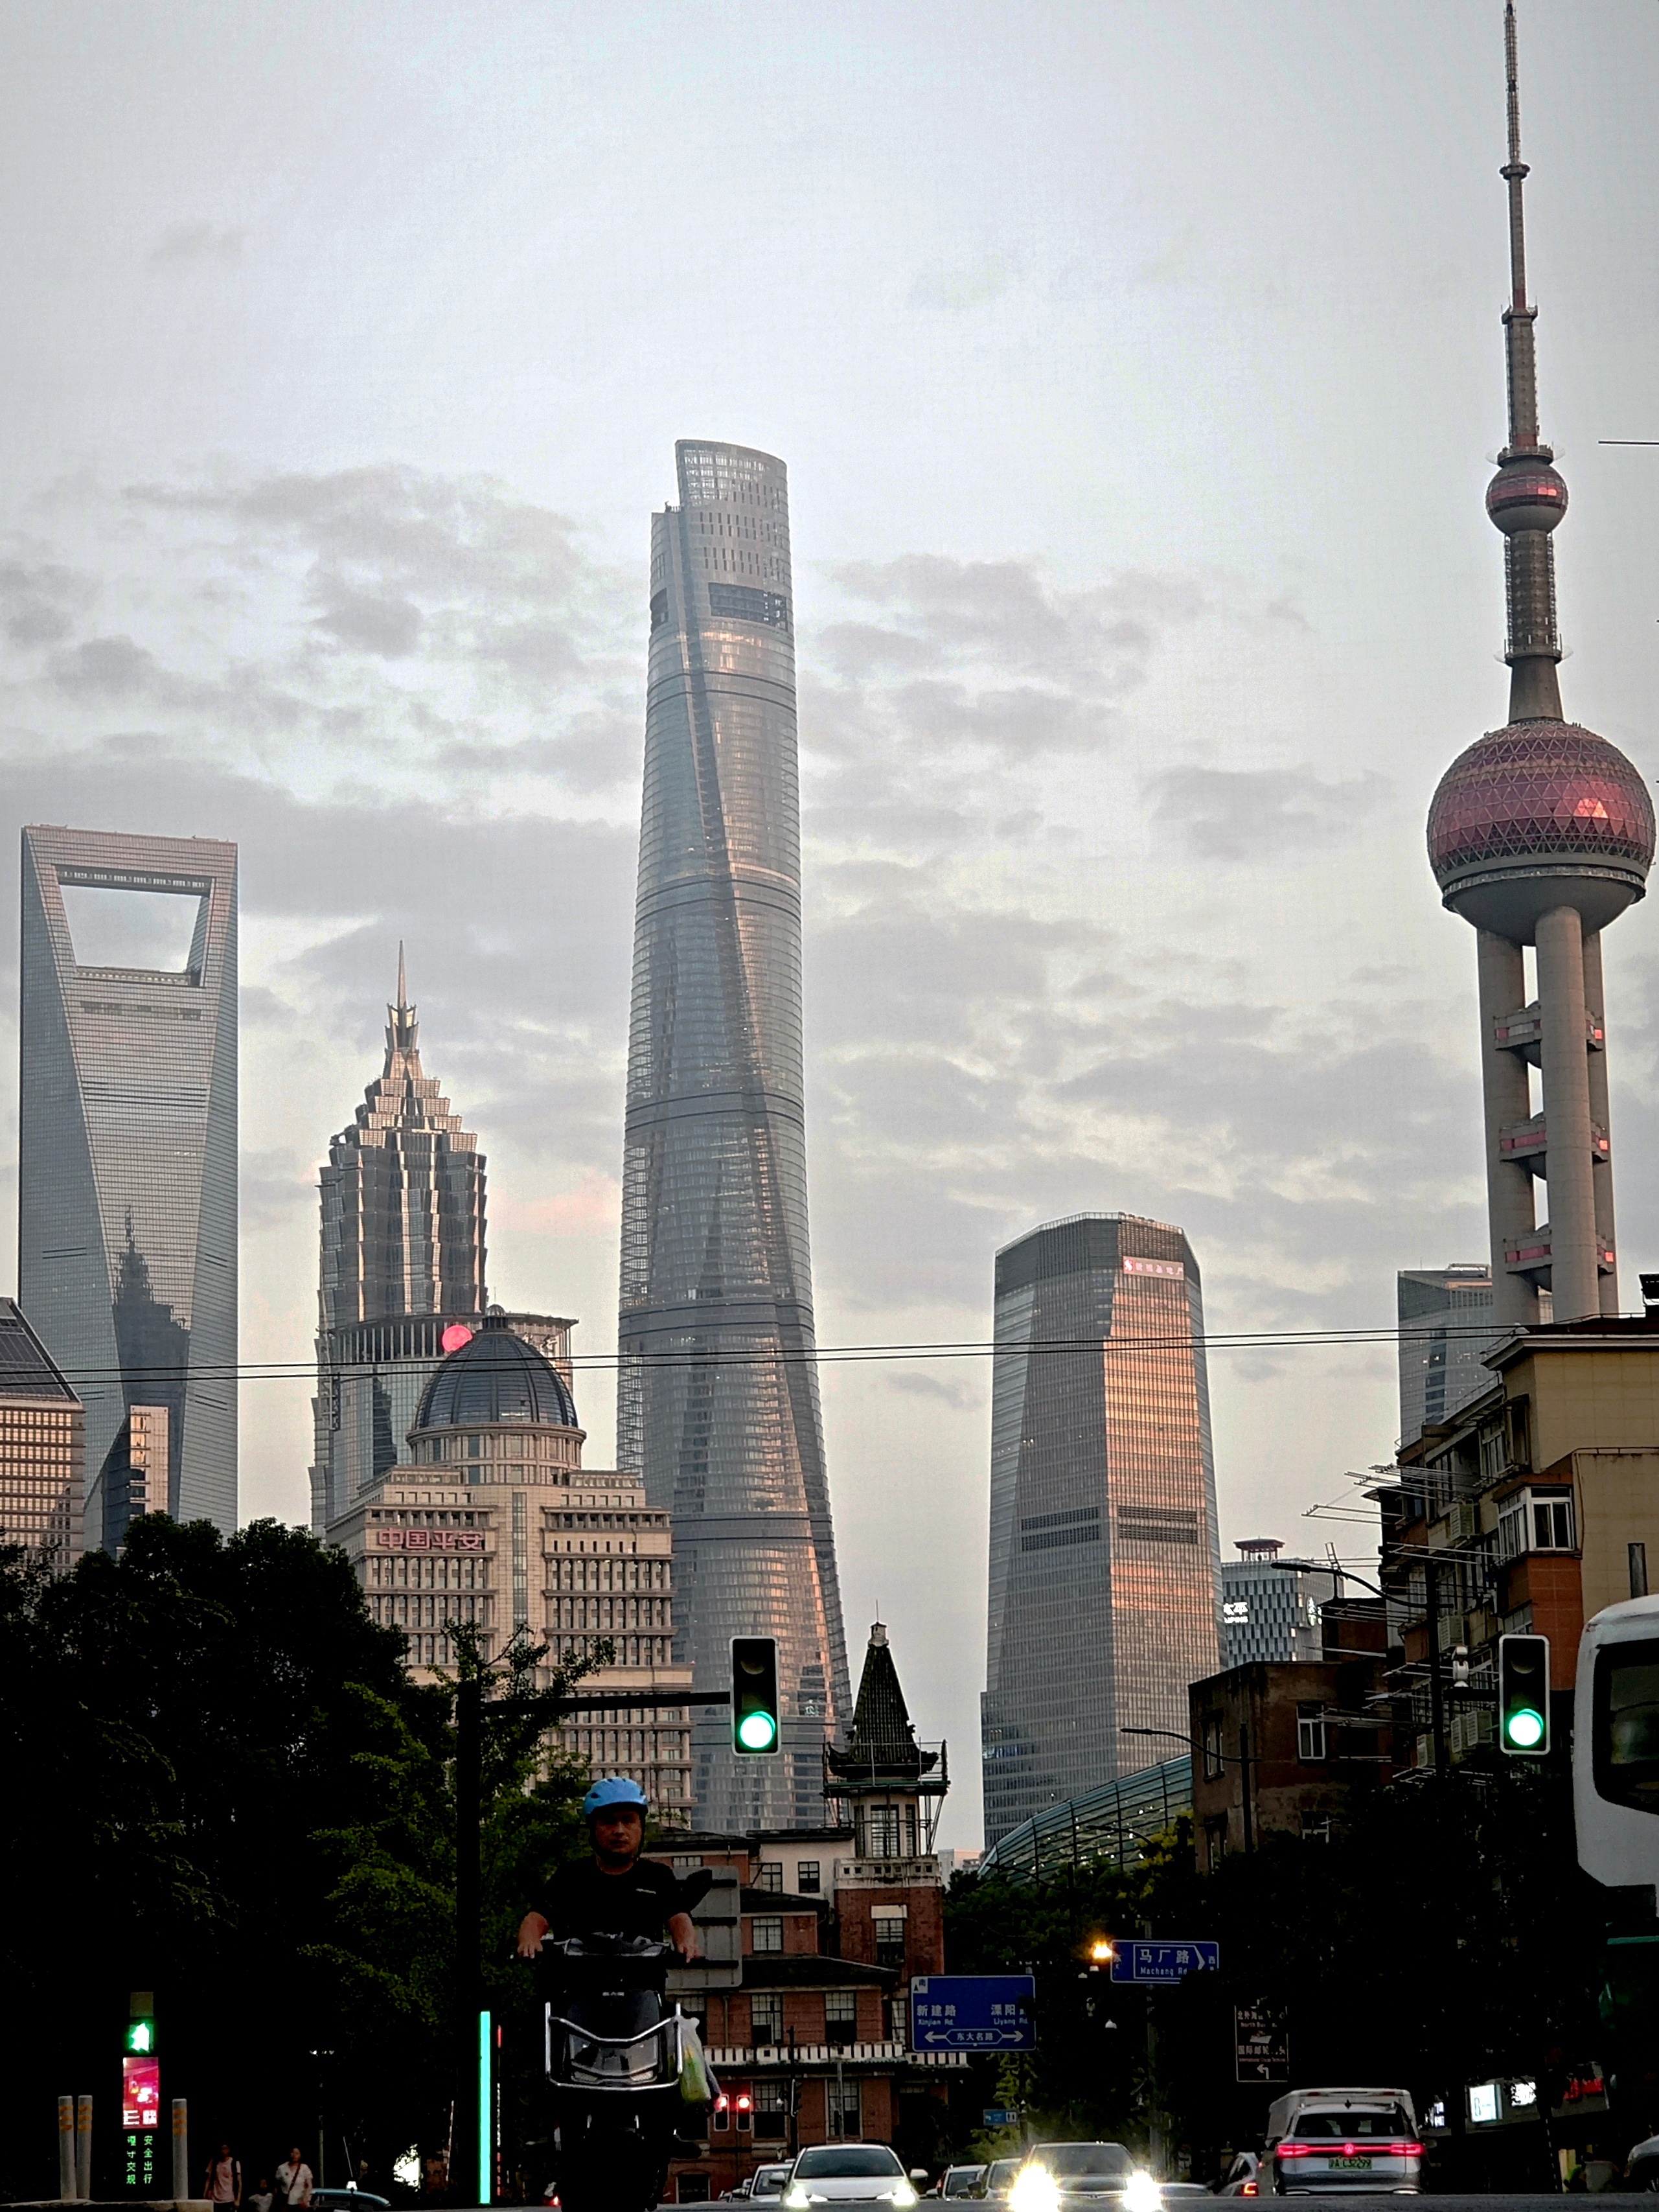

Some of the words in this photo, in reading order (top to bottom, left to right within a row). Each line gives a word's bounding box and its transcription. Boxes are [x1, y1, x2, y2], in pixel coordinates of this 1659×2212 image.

[379, 1528, 485, 1550] 中国平安
[1139, 1948, 1189, 1964] 马厂路
[1208, 1955, 1215, 1964] 西
[1140, 1966, 1174, 1977] Machang
[917, 2004, 956, 2016] 新建路
[918, 2018, 941, 2027] Xinjian
[993, 2017, 1016, 2025] Liyang
[956, 2032, 993, 2042] 东大名路
[1238, 2045, 1286, 2055] 国际邮轮头
[143, 2134, 154, 2184] 安全出行
